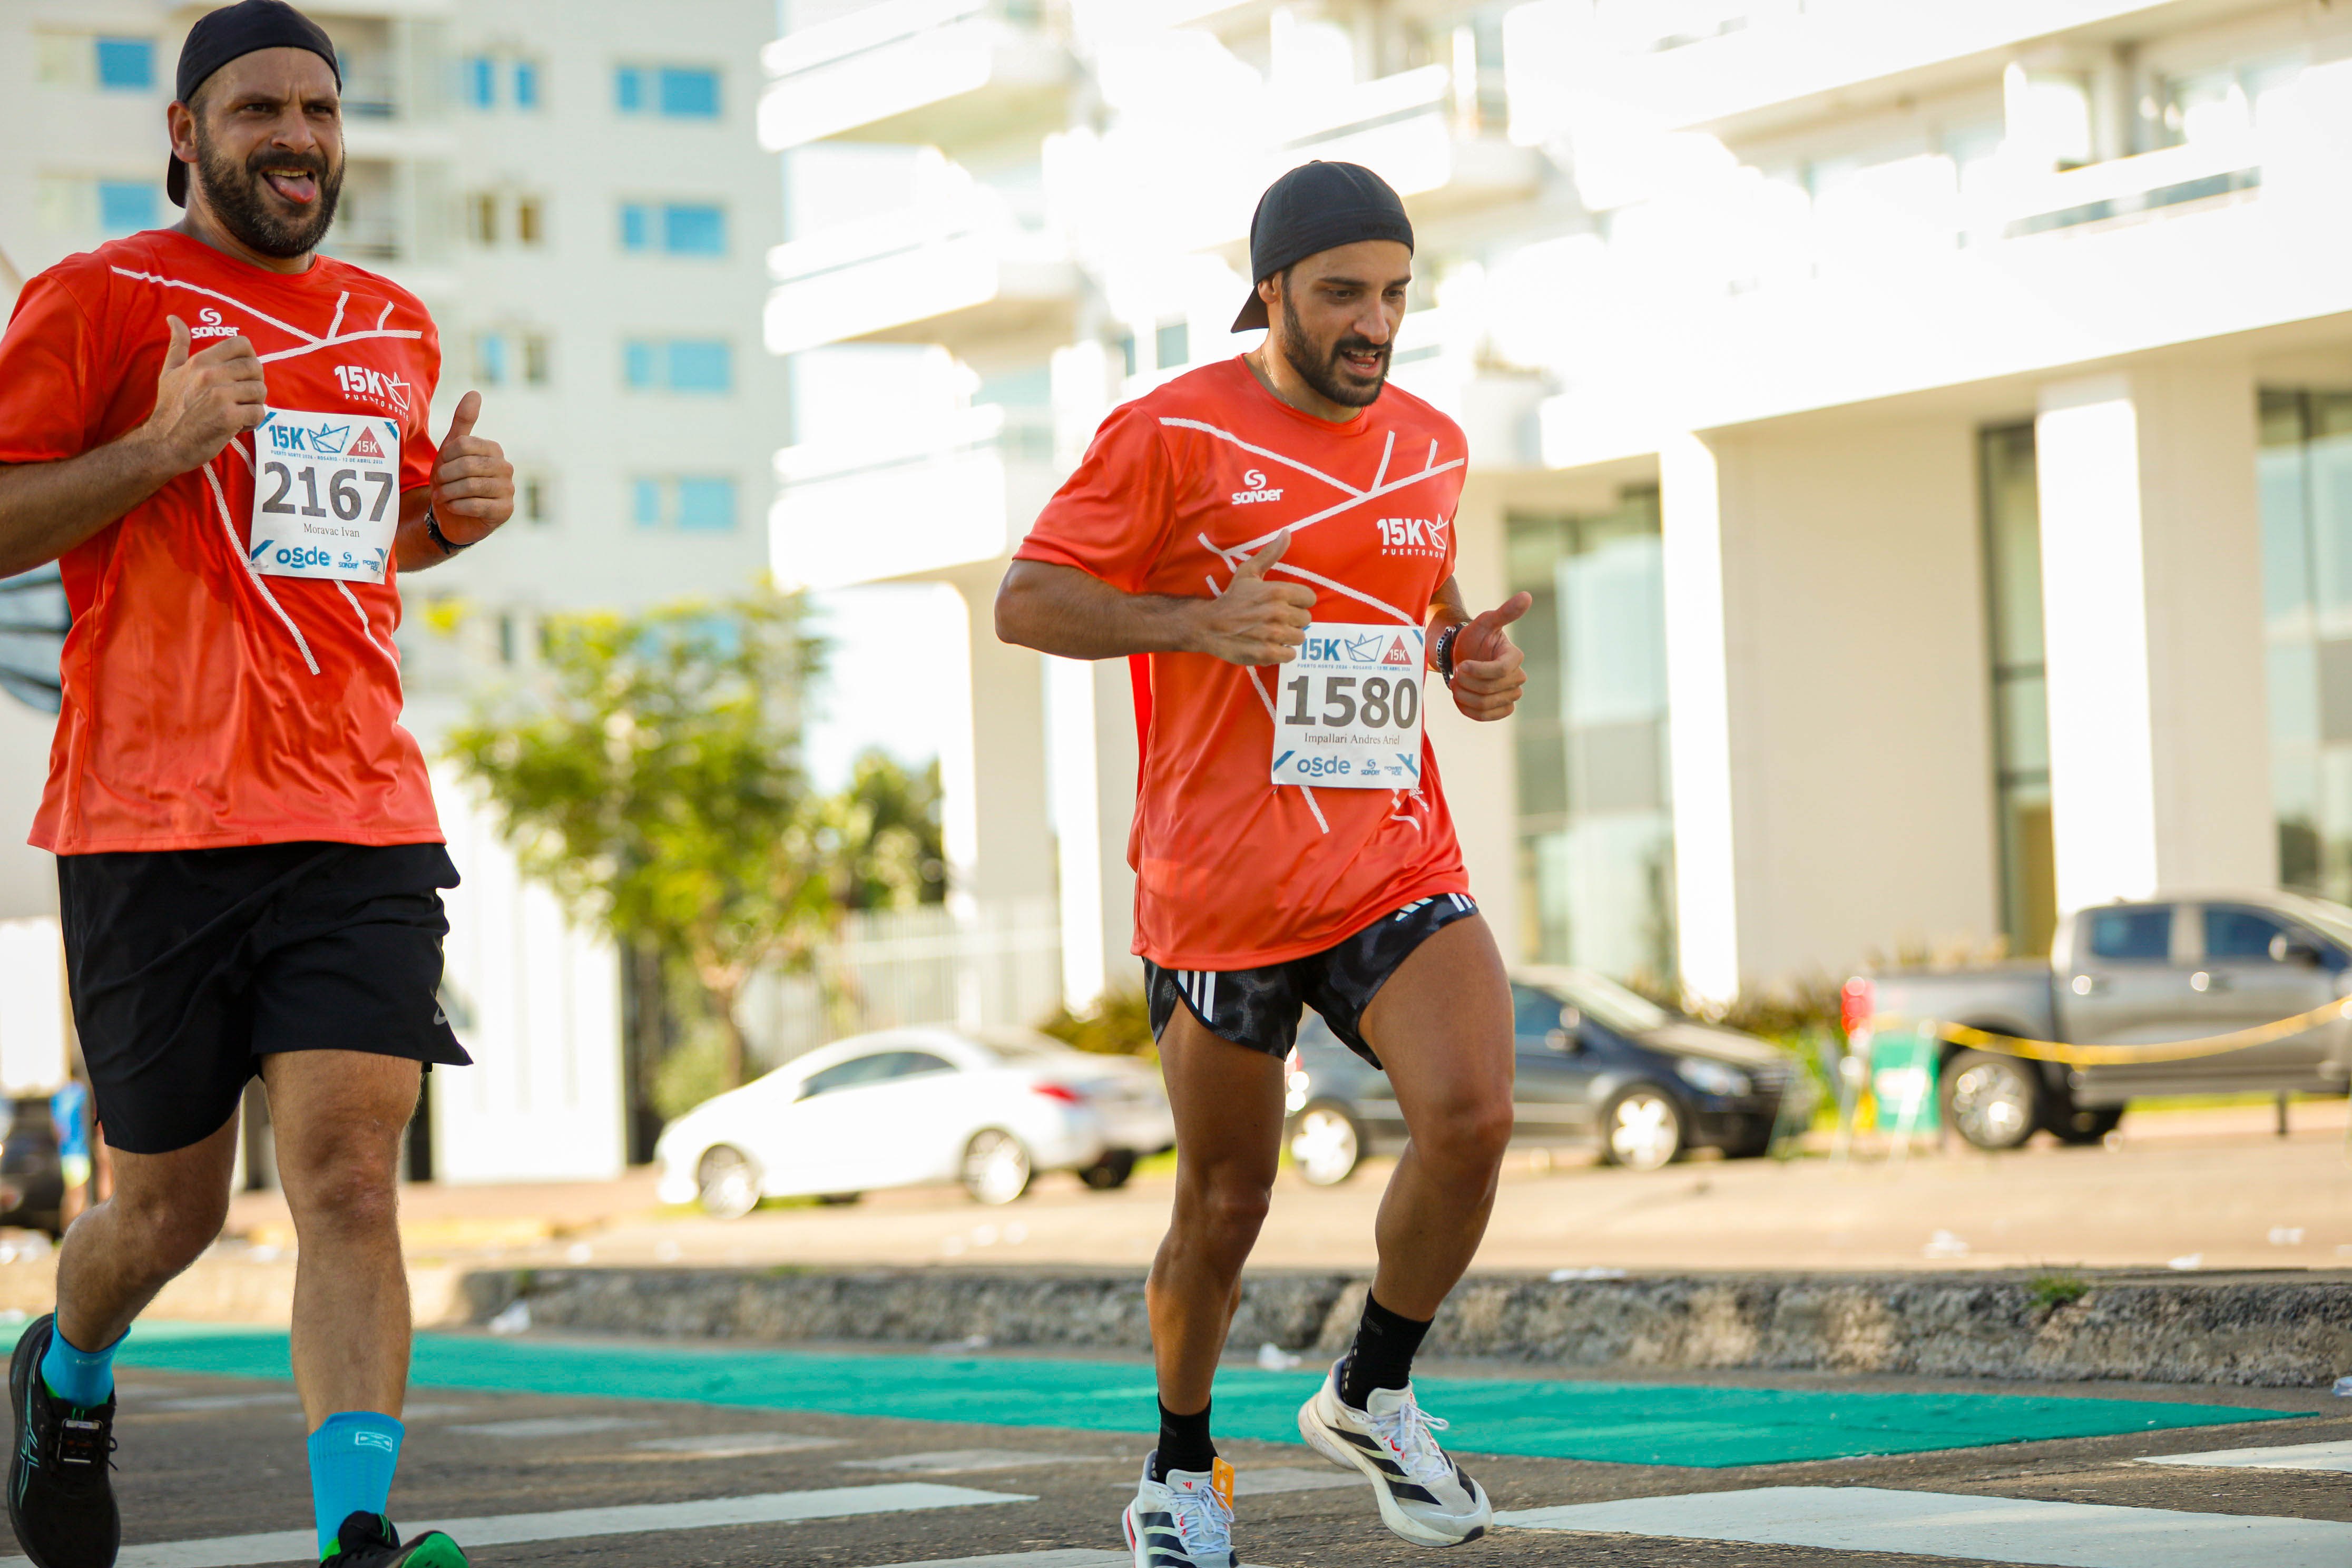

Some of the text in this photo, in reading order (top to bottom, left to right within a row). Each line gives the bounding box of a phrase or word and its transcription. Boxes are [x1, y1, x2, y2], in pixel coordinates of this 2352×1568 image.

[334, 365, 385, 397] 15K
[388, 403, 409, 422] NORTE
[268, 424, 378, 454] 15K 15K
[262, 461, 394, 522] 2167
[303, 523, 360, 537] Moravac Ivan
[1376, 518, 1426, 546] 15K
[276, 546, 331, 568] osde
[1301, 638, 1407, 661] 15K 15K
[1285, 675, 1418, 729] 1580
[1305, 732, 1400, 745] Impallari Andres Ariel
[1297, 755, 1351, 777] osde
